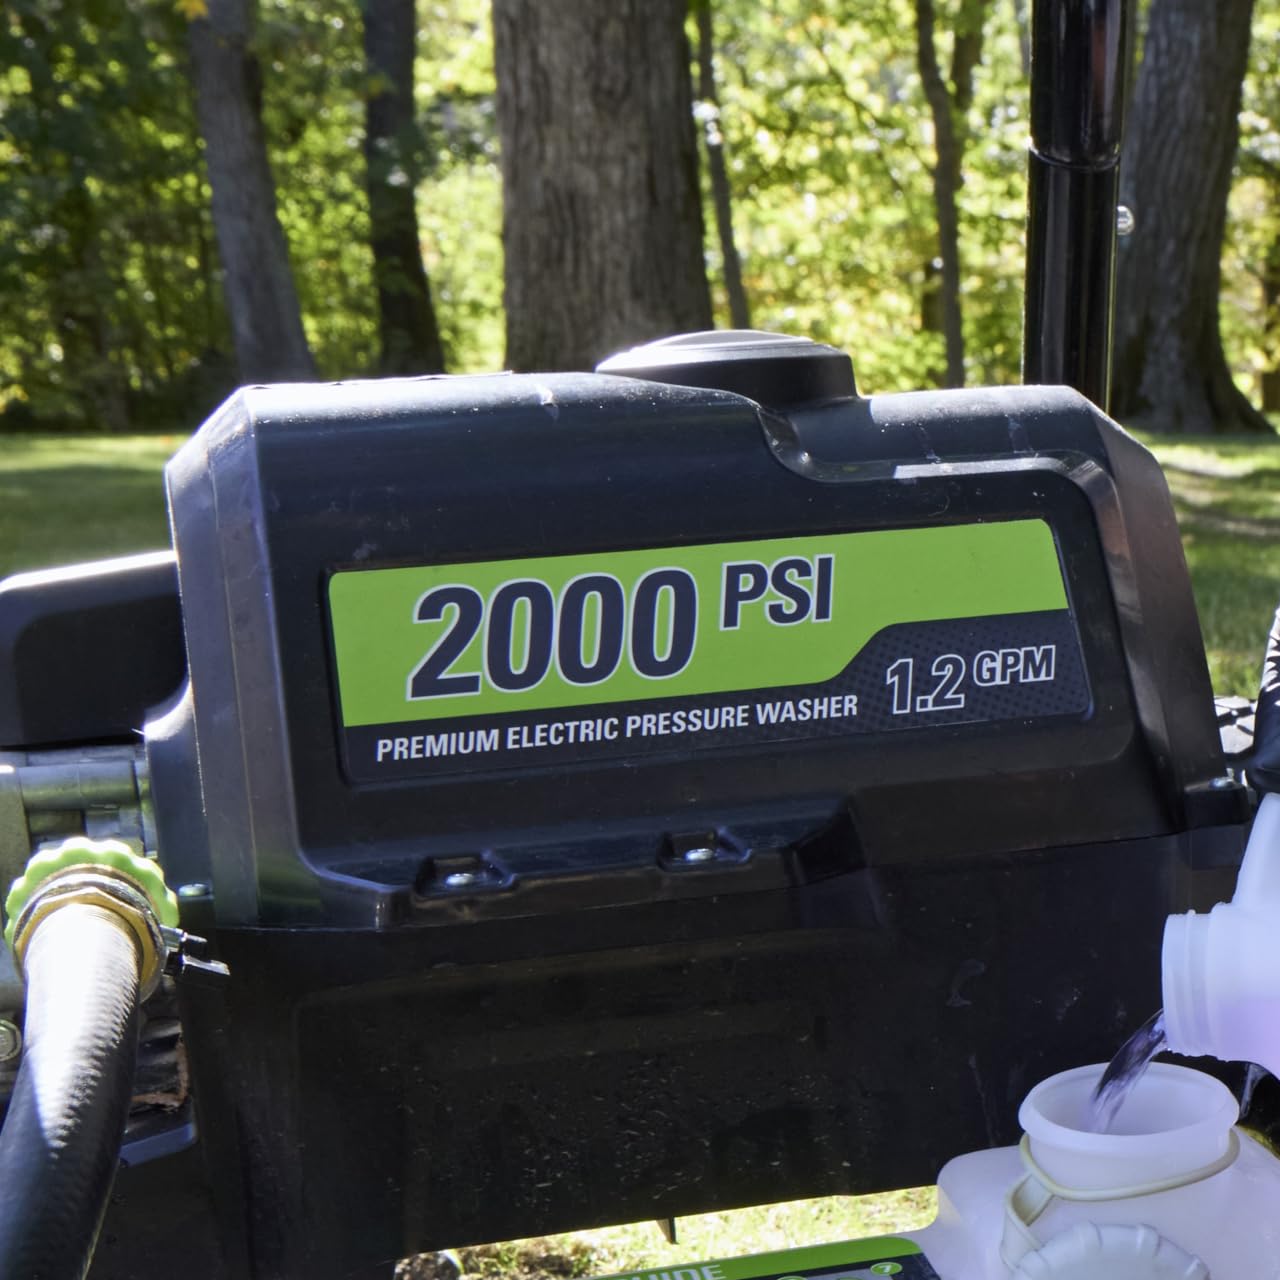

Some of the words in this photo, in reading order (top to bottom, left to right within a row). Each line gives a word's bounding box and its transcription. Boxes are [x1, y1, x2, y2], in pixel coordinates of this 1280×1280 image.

[407, 567, 699, 704] 2000
[719, 554, 835, 631] PSI
[885, 652, 966, 715] 1.2
[974, 645, 1056, 687] GPM
[377, 728, 499, 762] PREMIUM
[507, 716, 619, 750] ELECTRIC
[626, 705, 749, 737] PRESSURE
[755, 694, 858, 725] WASHER
